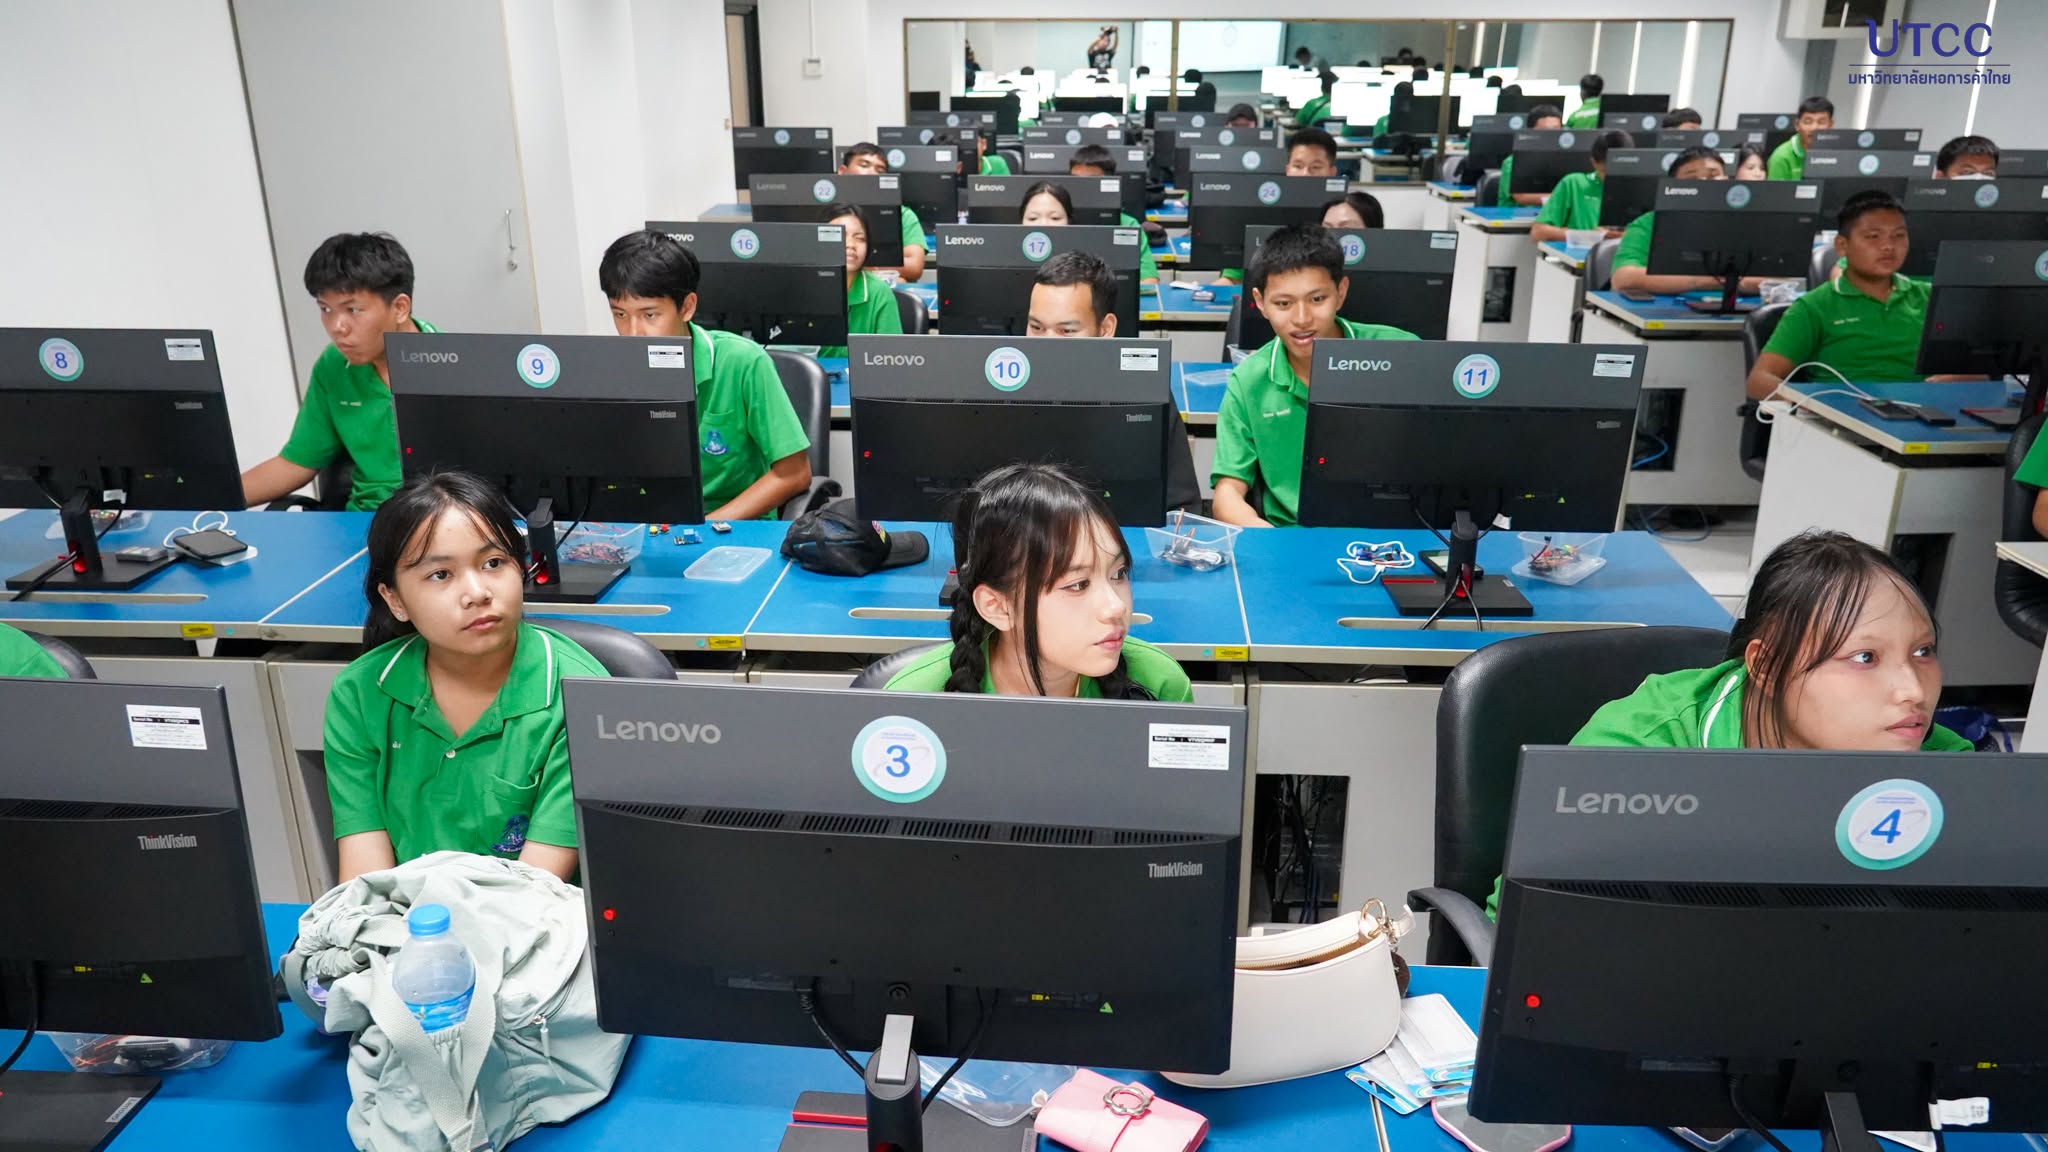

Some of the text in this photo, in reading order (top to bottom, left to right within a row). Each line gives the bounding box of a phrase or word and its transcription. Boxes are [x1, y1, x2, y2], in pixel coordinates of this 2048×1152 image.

[975, 183, 1006, 192] Lenovo
[1200, 182, 1231, 191] Lenovo
[1665, 186, 1698, 195] Lenovo
[667, 233, 694, 242] novo
[736, 239, 753, 250] 16
[945, 234, 984, 246] Lenovo
[1029, 241, 1046, 253] 17
[1343, 244, 1359, 256] 18
[54, 352, 68, 369] 8
[401, 350, 459, 364] Lenovo
[864, 351, 925, 366] Lenovo
[1328, 356, 1392, 371] Lenovo
[531, 358, 544, 376] 9
[994, 361, 1020, 379] 10
[1463, 368, 1488, 386] 11
[596, 714, 721, 744] Lenovo
[885, 745, 911, 778] 3
[1555, 787, 1699, 815] Lenovo
[1870, 808, 1902, 844] 4
[137, 832, 198, 851] ThinkVision
[1148, 860, 1203, 878] ThinkVision
